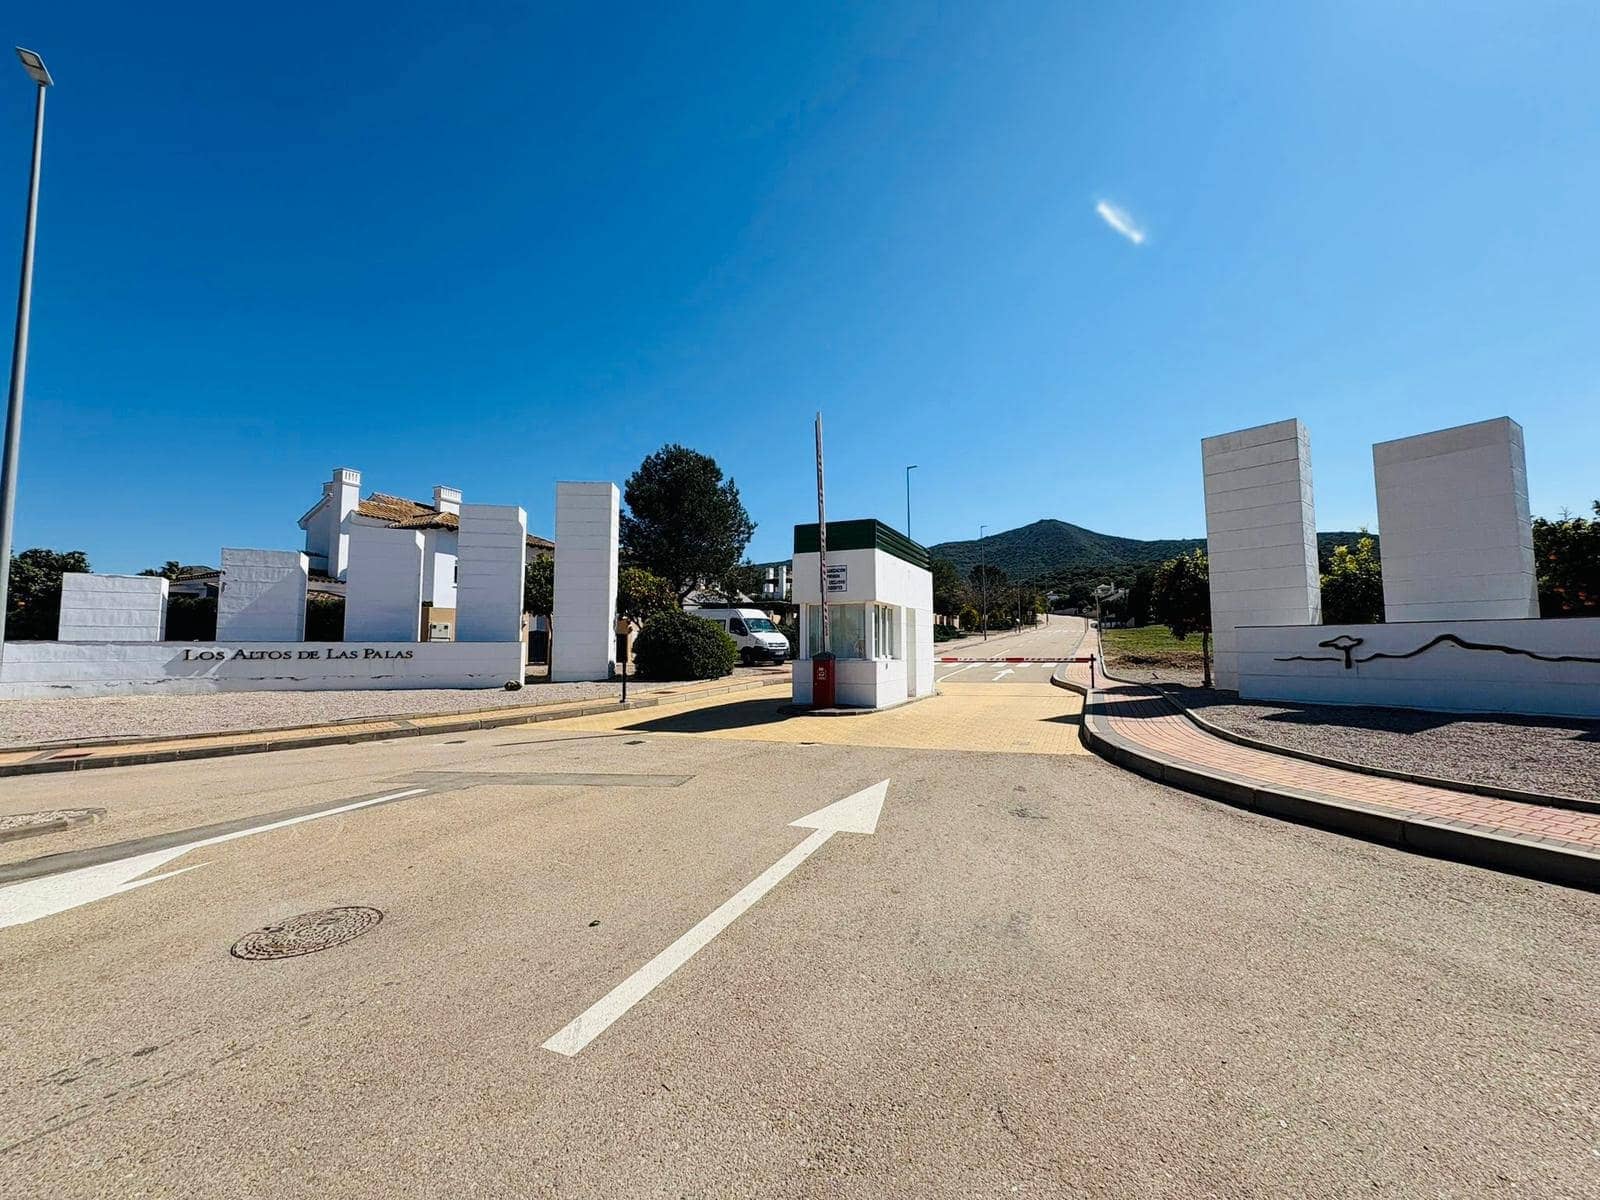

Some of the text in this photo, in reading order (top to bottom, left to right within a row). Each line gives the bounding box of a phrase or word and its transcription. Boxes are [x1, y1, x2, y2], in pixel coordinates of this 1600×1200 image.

[183, 648, 414, 661] LOS ALTOS DE LAS PALAS
